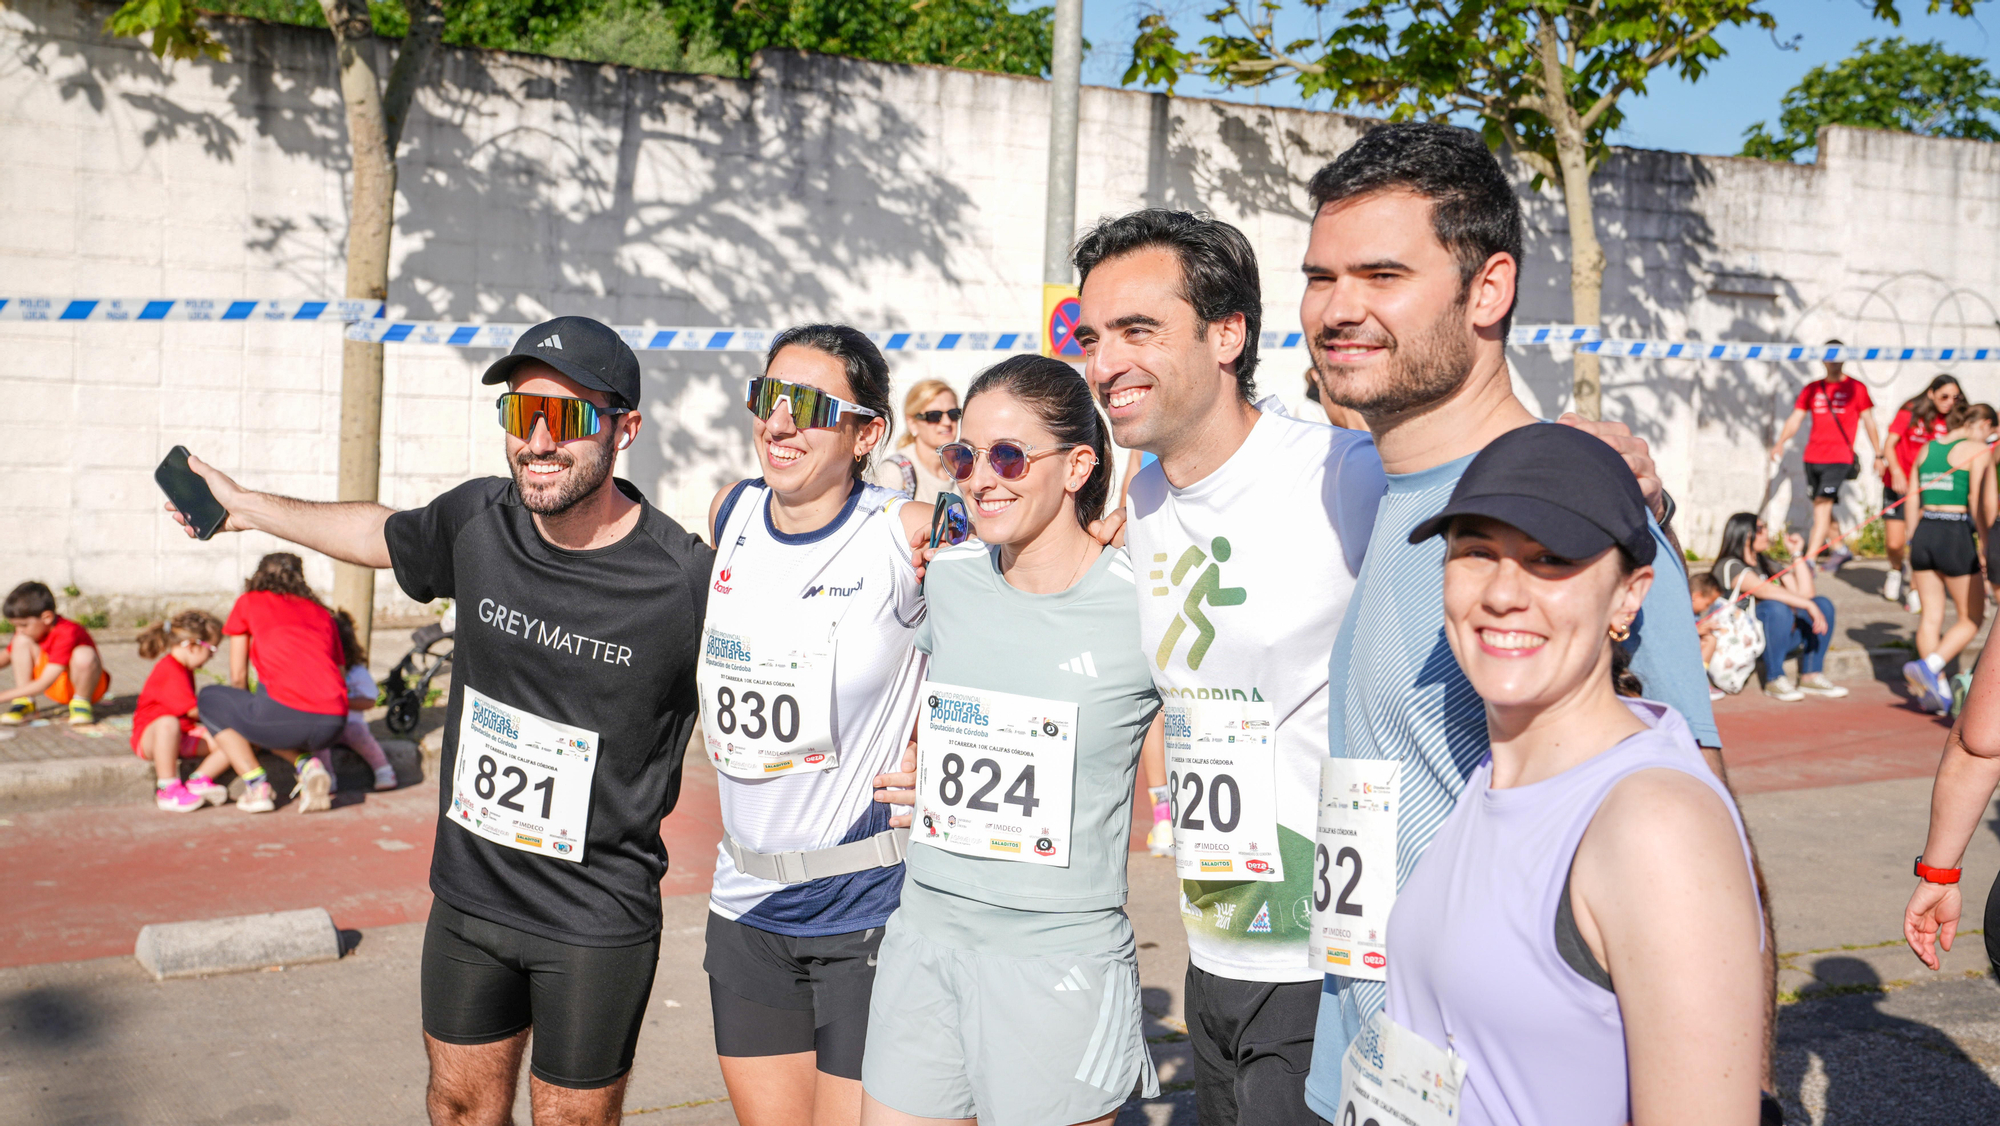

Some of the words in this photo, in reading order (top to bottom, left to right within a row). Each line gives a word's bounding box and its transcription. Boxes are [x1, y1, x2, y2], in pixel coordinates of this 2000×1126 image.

[478, 598, 633, 667] GREYMATTER
[717, 686, 801, 743] 830
[937, 698, 981, 715] arreras
[472, 710, 519, 740] populares
[930, 707, 990, 727] populares
[955, 727, 962, 735] de
[963, 727, 989, 738] Córdoba
[1210, 758, 1234, 766] CÓRDOBA
[474, 754, 556, 820] 821
[939, 752, 1040, 818] 824
[1169, 770, 1241, 833] 820
[993, 823, 1023, 834] IMDECO
[991, 840, 1019, 848] SALADITOS
[1201, 842, 1230, 851] IMDECO
